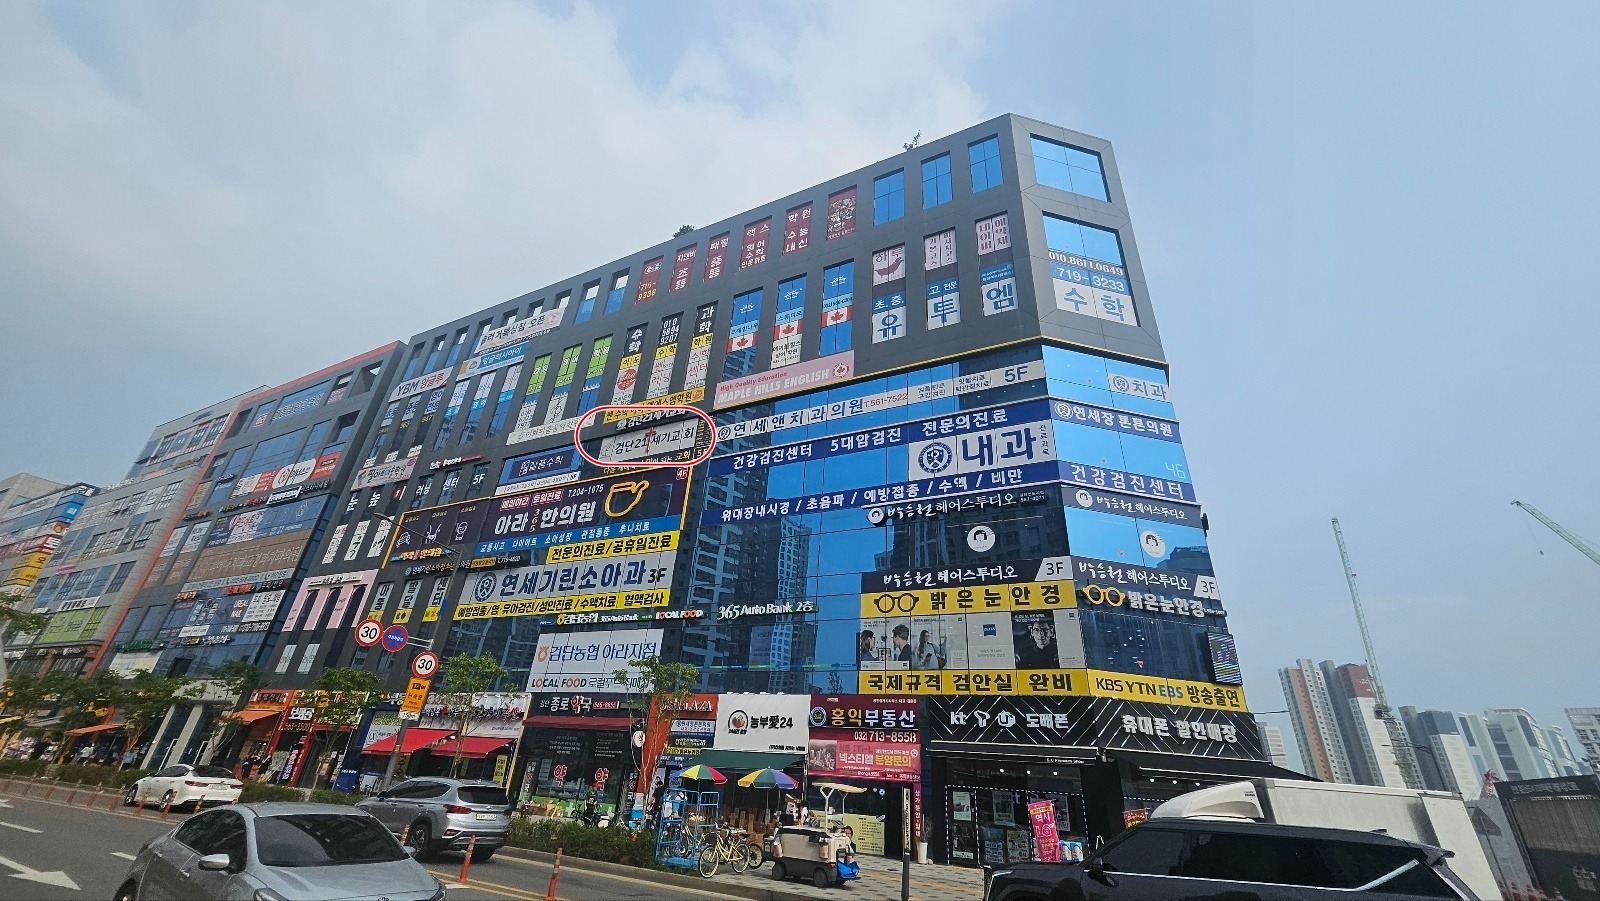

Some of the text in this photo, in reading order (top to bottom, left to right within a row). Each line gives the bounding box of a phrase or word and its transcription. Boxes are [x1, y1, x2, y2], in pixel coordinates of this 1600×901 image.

[1049, 251, 1124, 277] 010.8611.0649
[985, 283, 1015, 311] 엠
[1063, 287, 1126, 323] 수학
[930, 300, 958, 324] 투
[664, 318, 678, 328] 010
[877, 314, 903, 338] 유
[720, 371, 788, 392] High Quality Education
[1004, 366, 1028, 383] 5F
[396, 380, 420, 396] YBM
[718, 368, 830, 404] MAPLE HILLS ENGLISH
[1133, 380, 1167, 400] 치과
[733, 398, 864, 437] 연세앤치과의원
[615, 427, 694, 455] 검단21세기교회
[733, 408, 1008, 470] 건강검진센터 5대암검진 전문의진료
[961, 426, 1037, 467] 내과
[674, 450, 691, 461] 교회
[472, 473, 486, 485] 5F
[1071, 464, 1185, 500] 건강검진센터
[721, 500, 790, 522] 위대장내시경
[806, 494, 845, 510] 초음파
[863, 483, 920, 503] 예방접종
[938, 475, 968, 493] 수액
[991, 468, 1023, 486] 비만
[494, 510, 529, 535] 아라
[540, 500, 597, 529] 한의원
[887, 501, 937, 520] 박승철
[480, 541, 505, 554] 교통사고
[511, 537, 538, 549] 다이어트
[551, 535, 672, 561] 전문의진료/공휴일진료
[500, 560, 668, 598] 연세기린소아과 3F
[883, 570, 937, 589] 박승철
[1045, 561, 1065, 576] 3F
[1079, 562, 1128, 584] 박승철
[1202, 580, 1216, 594] 3F
[623, 592, 665, 607] 혈액검사
[795, 600, 814, 613] 2층
[930, 584, 1061, 611] 밝은눈안경
[1127, 590, 1205, 618] 밝은눈안경
[656, 609, 704, 620] LOCAL FOOD
[360, 625, 378, 640] 30
[549, 641, 657, 662] 검단농협 아라지점
[417, 658, 433, 671] 30
[531, 677, 560, 689] LOCAL
[561, 677, 587, 689] FOOD
[868, 673, 1073, 692] 국제규격 검안실 완비
[1095, 677, 1241, 708] KBS YTN EBS 방송출연
[550, 695, 592, 714] 종로약국
[750, 714, 794, 730] 농부愛24
[830, 707, 917, 728] 홍익부동산
[950, 711, 967, 726] kt
[1121, 714, 1238, 744] 휴대폰 할인매장
[875, 754, 912, 768] 분양문의
